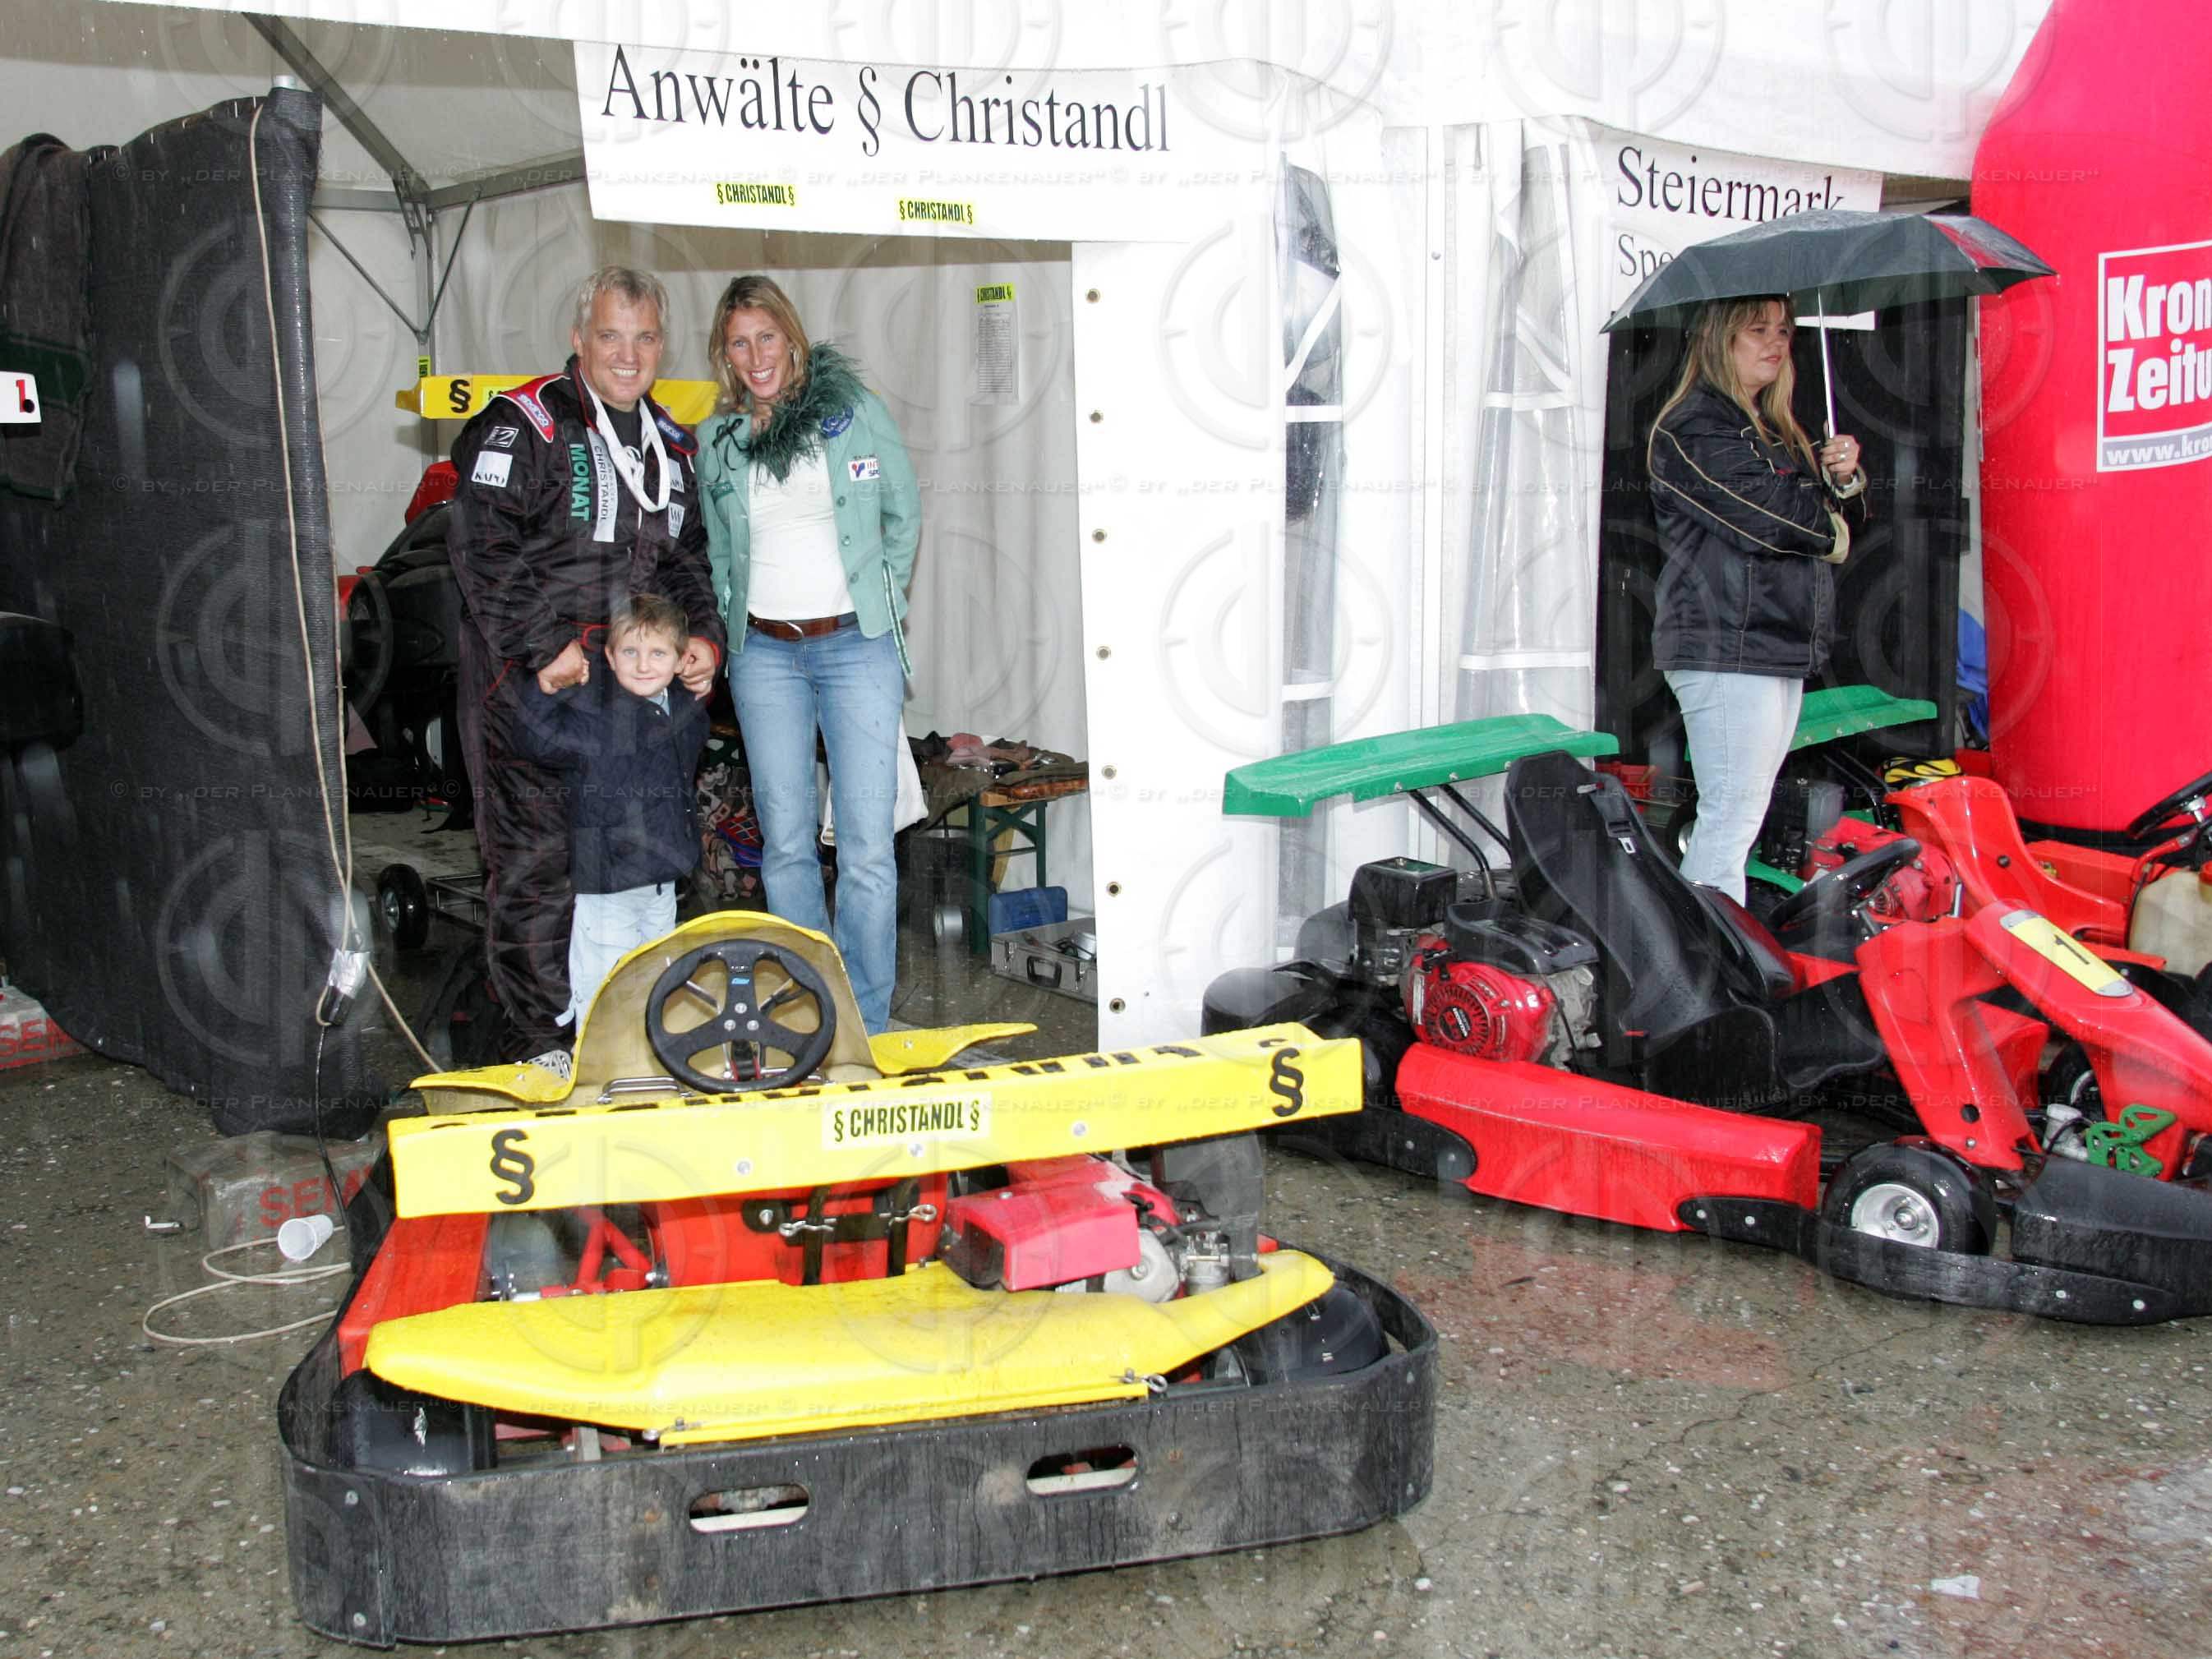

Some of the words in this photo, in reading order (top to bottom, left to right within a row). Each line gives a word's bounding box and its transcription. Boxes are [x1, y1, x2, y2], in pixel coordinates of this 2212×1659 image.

[601, 44, 836, 135] Anwälte
[904, 71, 1171, 151] Christandl
[726, 184, 787, 204] CHRISTANDL
[907, 200, 965, 222] CHRISTANDL
[1617, 149, 1845, 223] Steiermark
[569, 443, 592, 522] MONAT
[850, 1101, 965, 1138] CHRISTANDL
